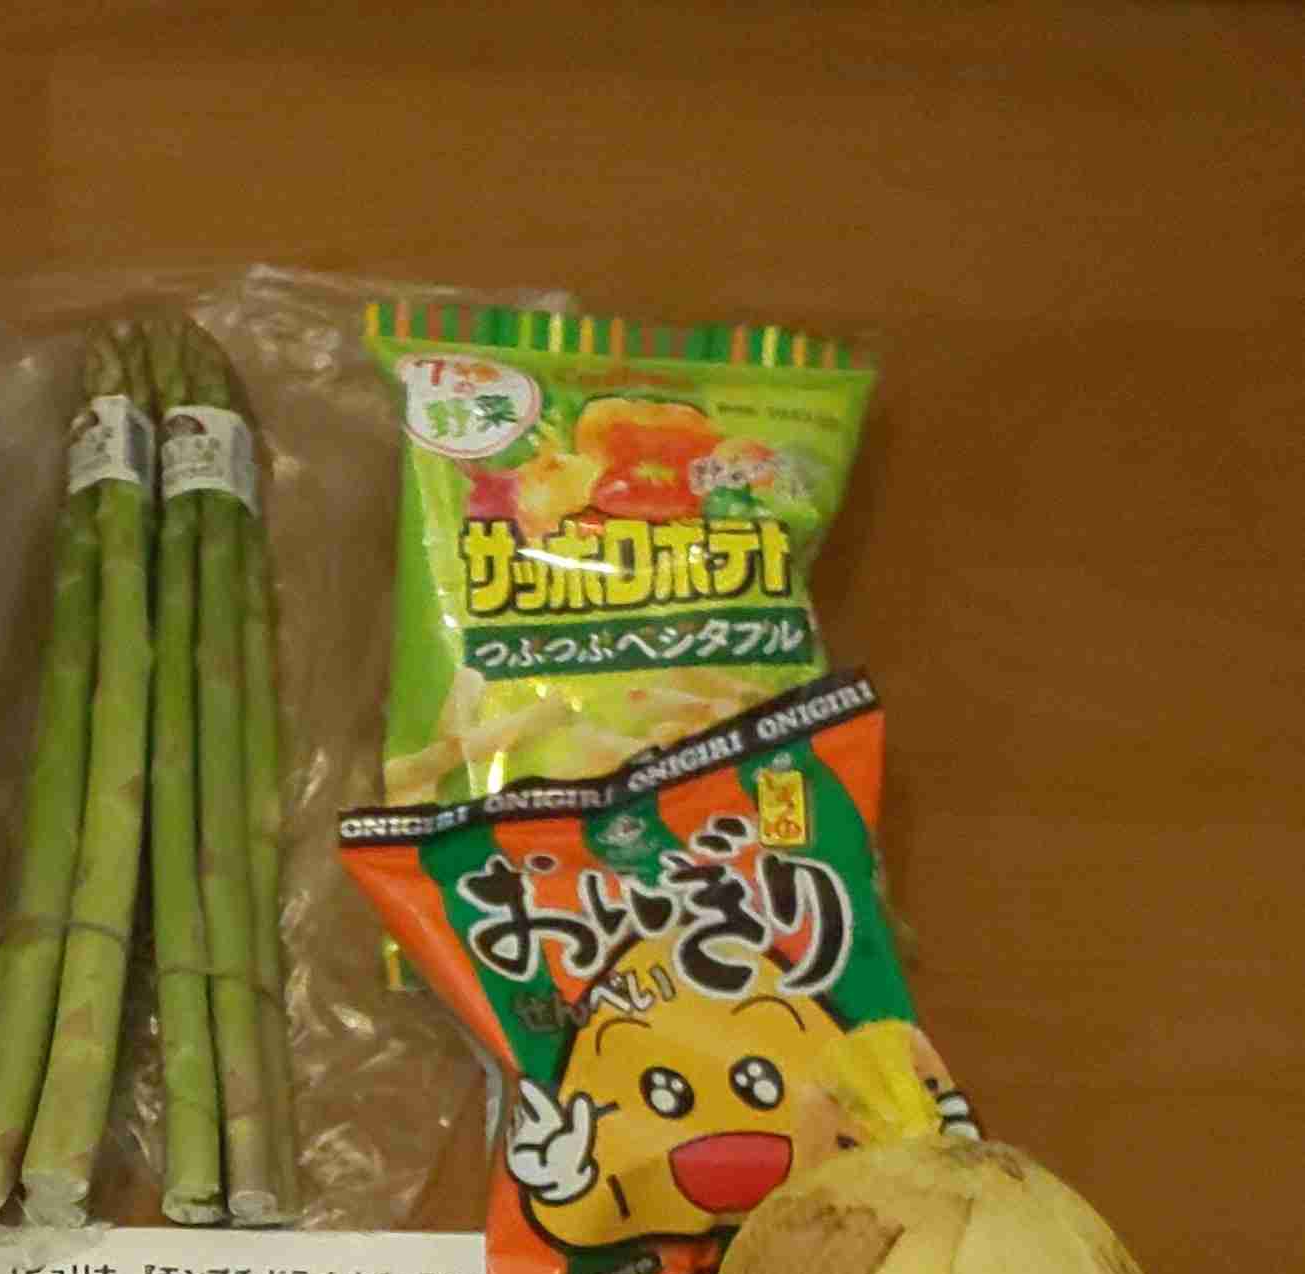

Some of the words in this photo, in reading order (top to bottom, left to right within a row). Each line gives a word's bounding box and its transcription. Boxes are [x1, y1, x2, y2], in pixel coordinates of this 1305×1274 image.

[627, 729, 745, 794] ONIGIRI
[756, 679, 877, 742] ONIGIRI
[457, 816, 853, 999] おにぎり
